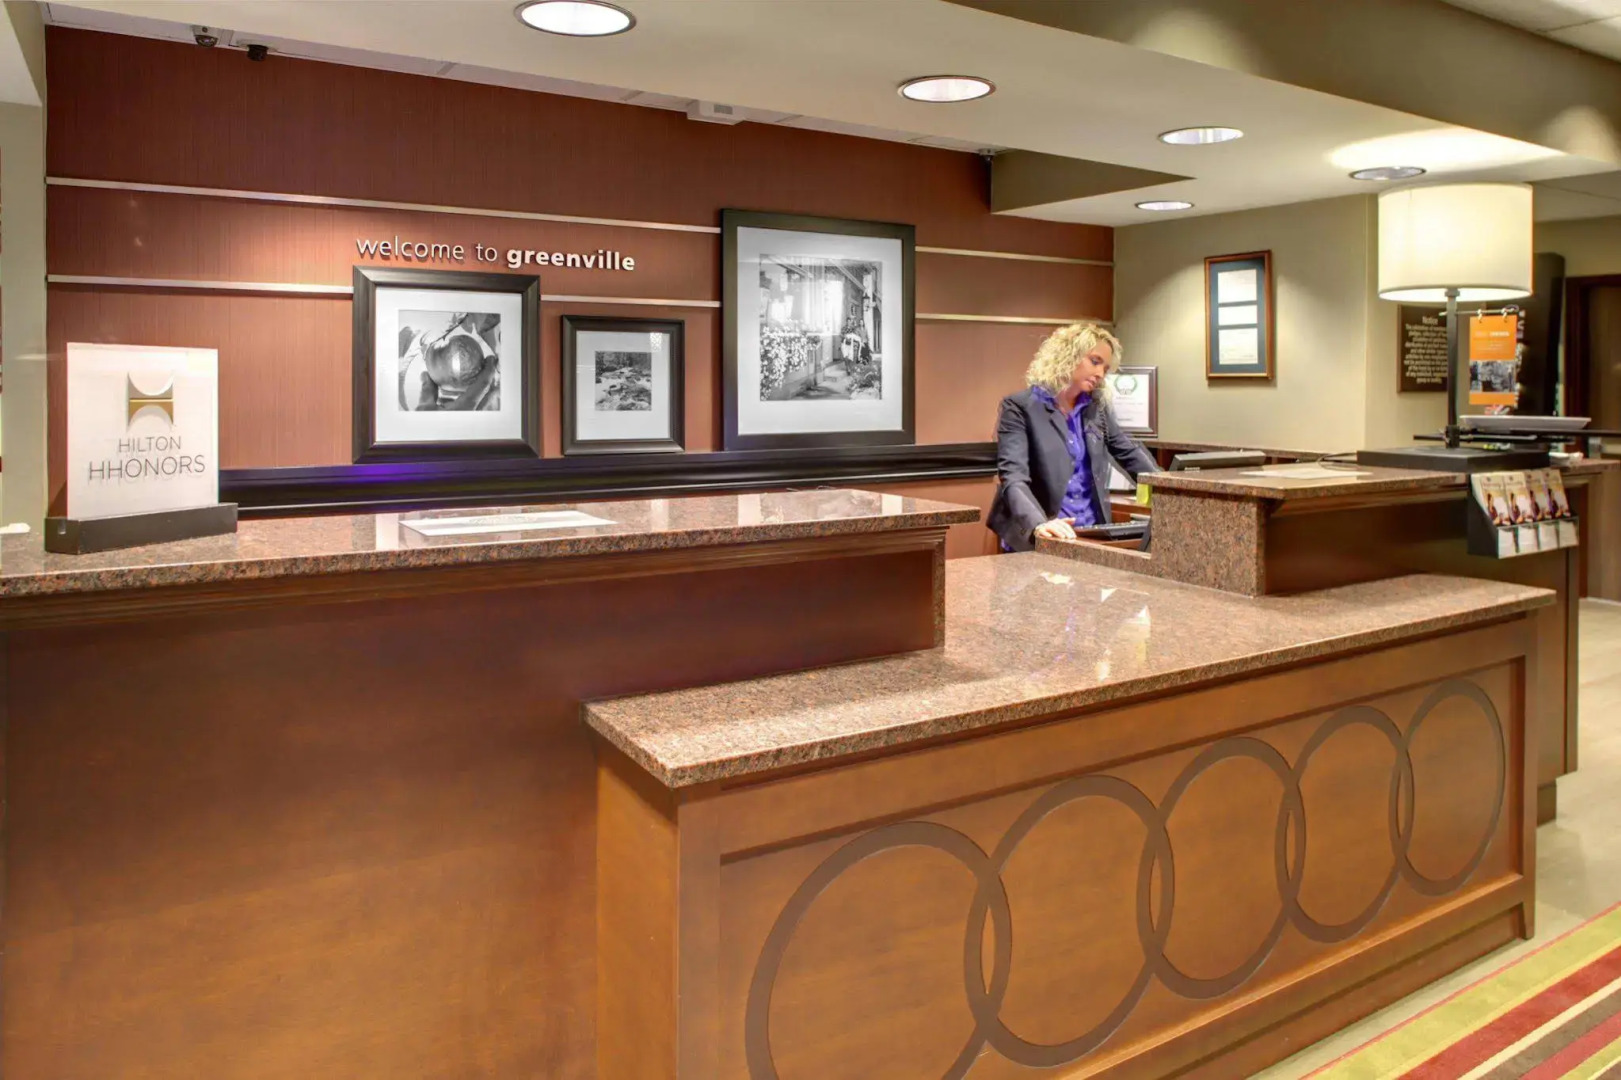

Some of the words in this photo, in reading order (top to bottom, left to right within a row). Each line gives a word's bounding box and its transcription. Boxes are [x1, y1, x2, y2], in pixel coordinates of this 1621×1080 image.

[356, 236, 464, 260] welcome
[475, 243, 498, 262] to
[506, 248, 635, 271] greenville
[118, 436, 182, 453] HILTON
[89, 454, 206, 480] HHONORS
